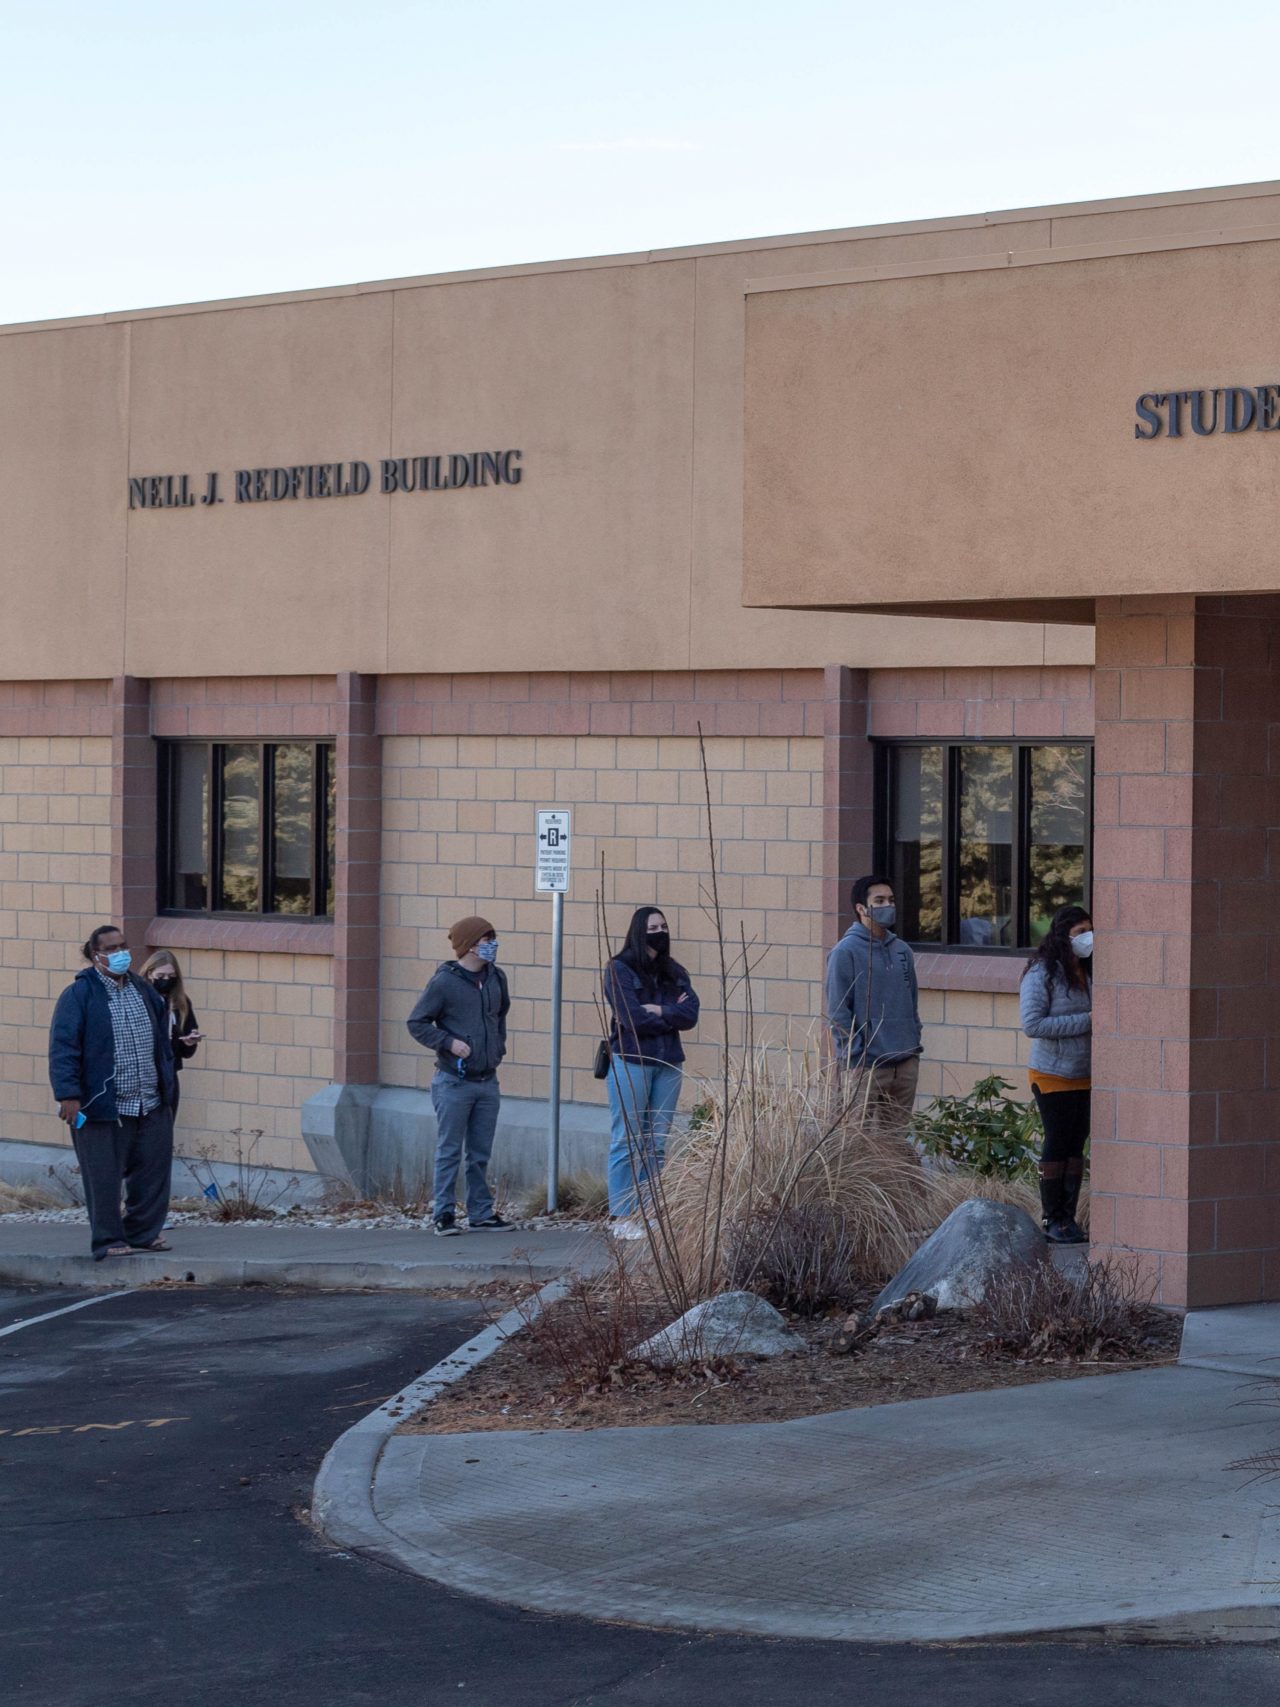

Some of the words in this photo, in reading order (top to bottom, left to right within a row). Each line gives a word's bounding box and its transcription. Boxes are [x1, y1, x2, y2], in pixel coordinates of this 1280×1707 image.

[127, 474, 196, 510] NELL
[200, 472, 224, 506] J.
[234, 460, 371, 504] REDFIELD
[379, 449, 523, 495] BUILDING
[549, 829, 558, 845] R
